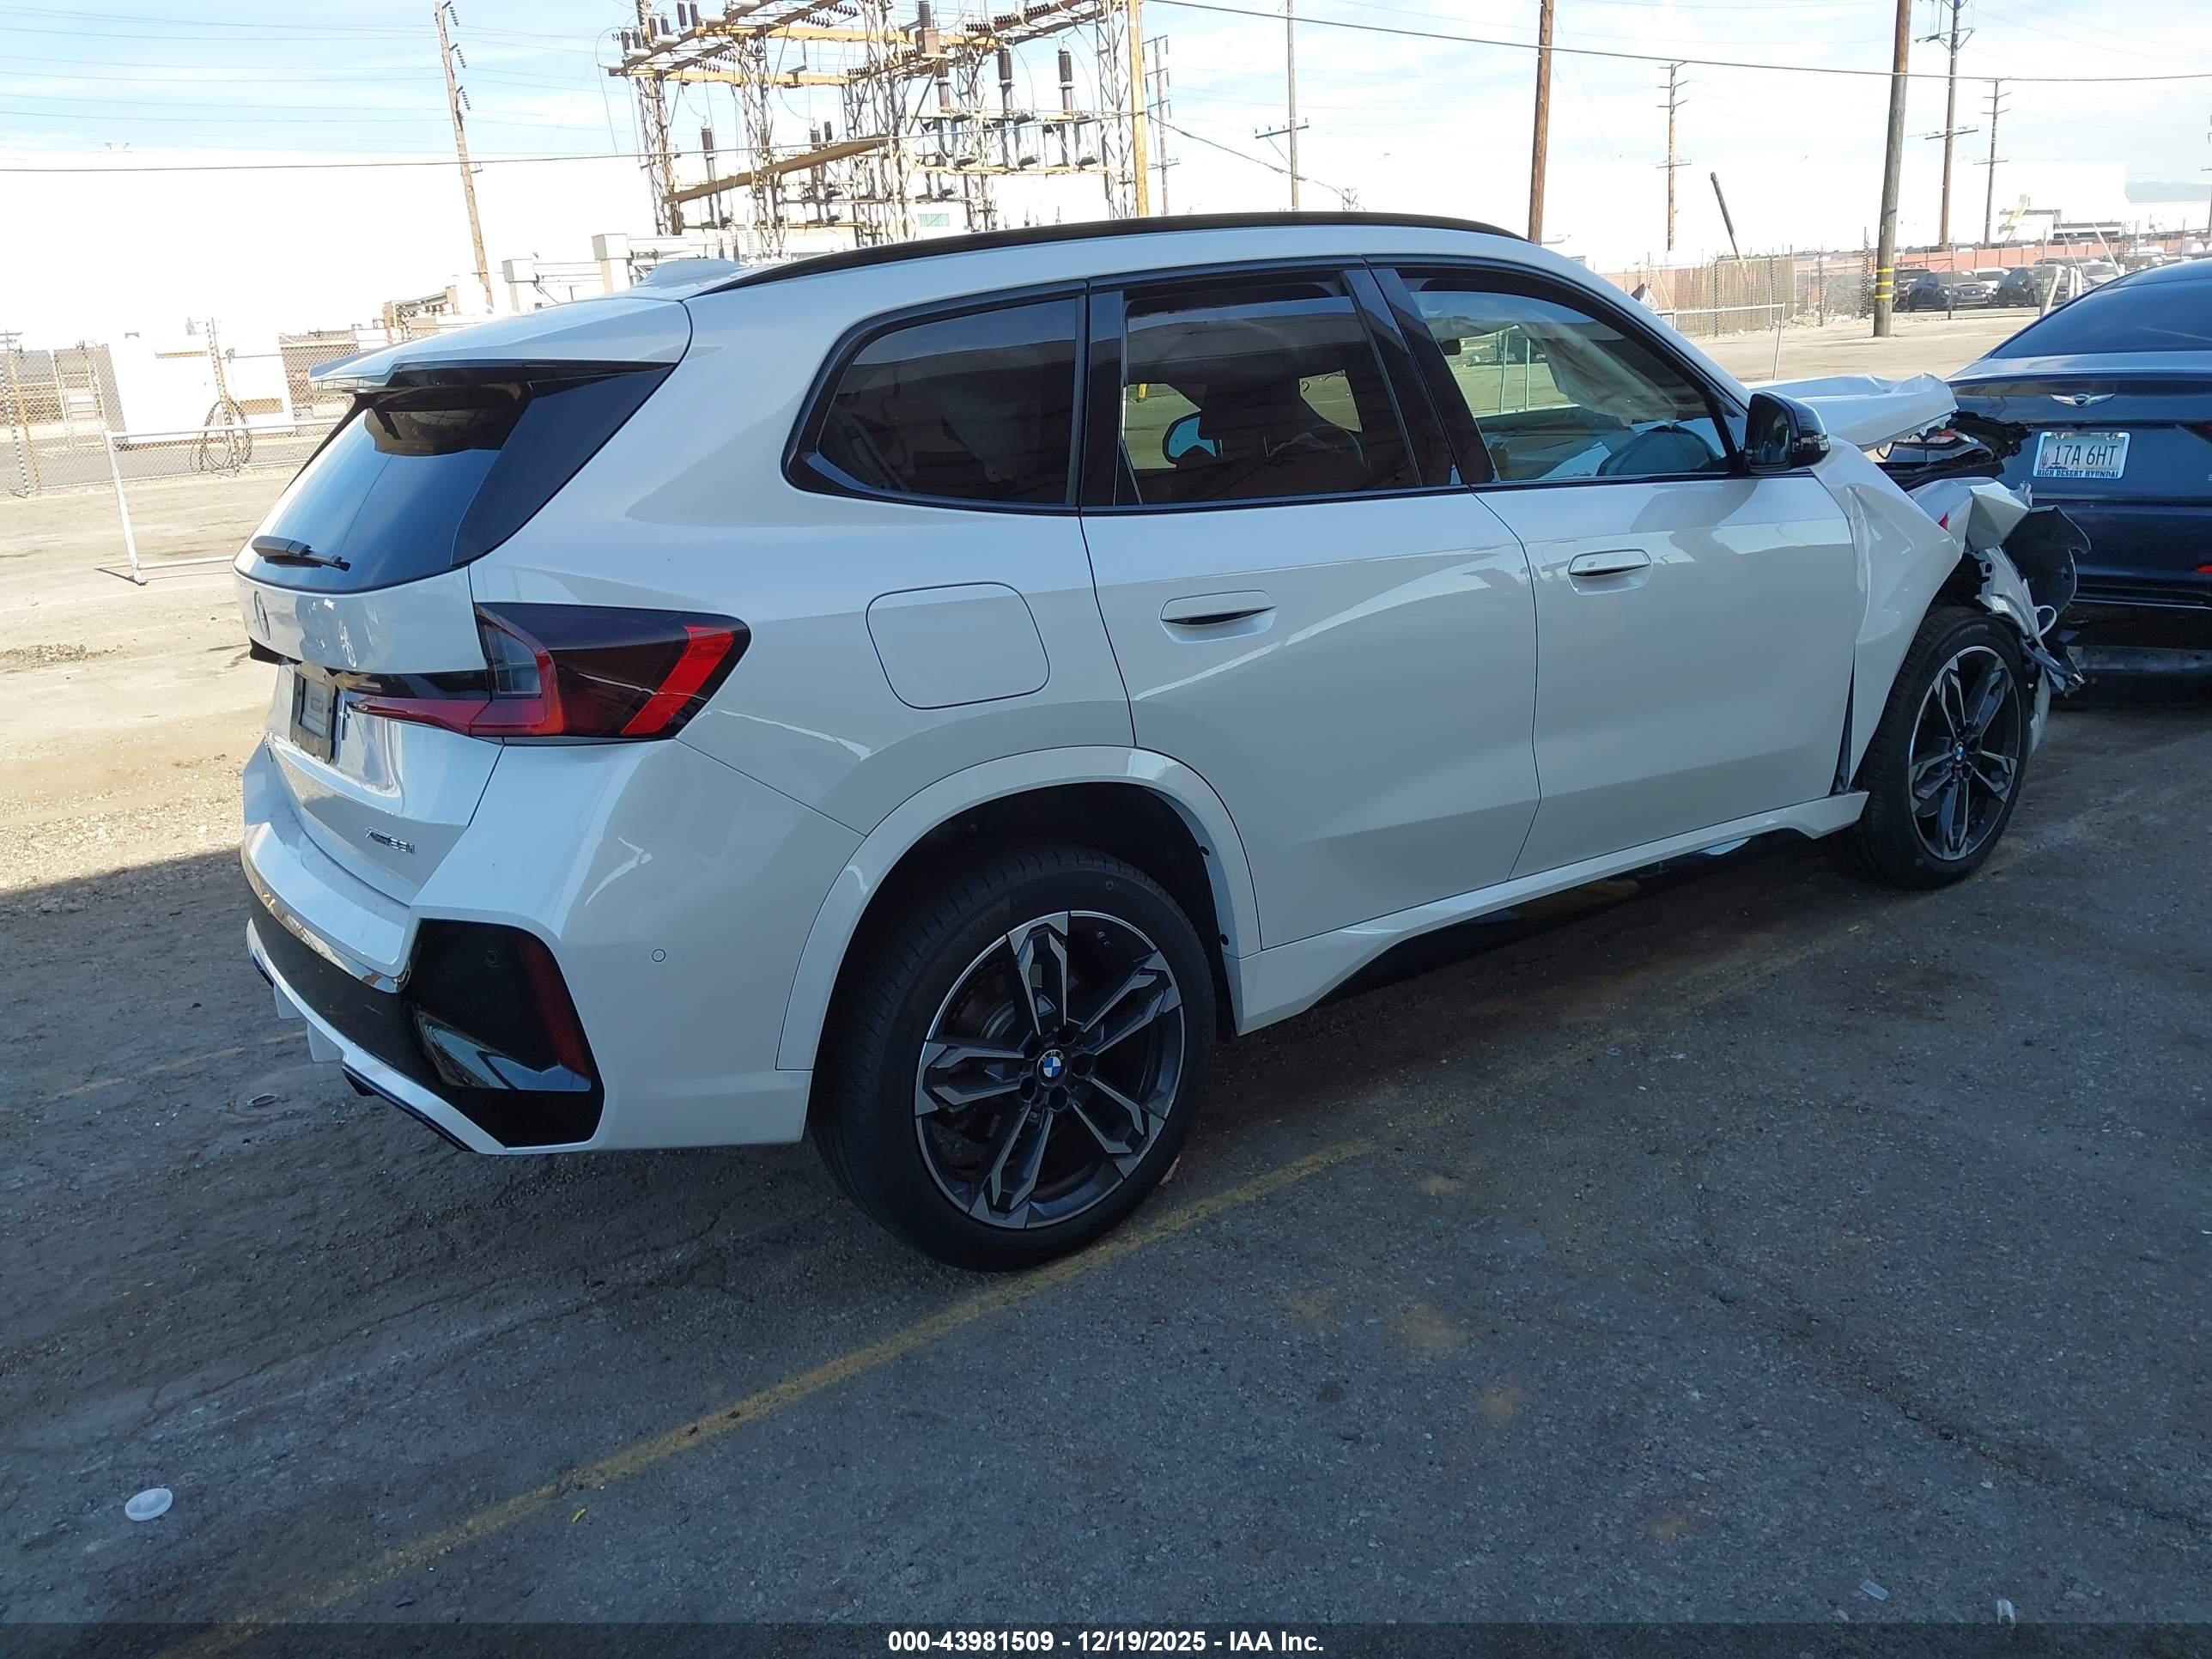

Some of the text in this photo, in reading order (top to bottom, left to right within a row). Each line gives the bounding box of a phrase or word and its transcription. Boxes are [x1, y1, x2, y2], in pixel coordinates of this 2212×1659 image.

[2051, 445, 2118, 465] 17A 6HT
[2085, 470, 2119, 478] HYUNDAI
